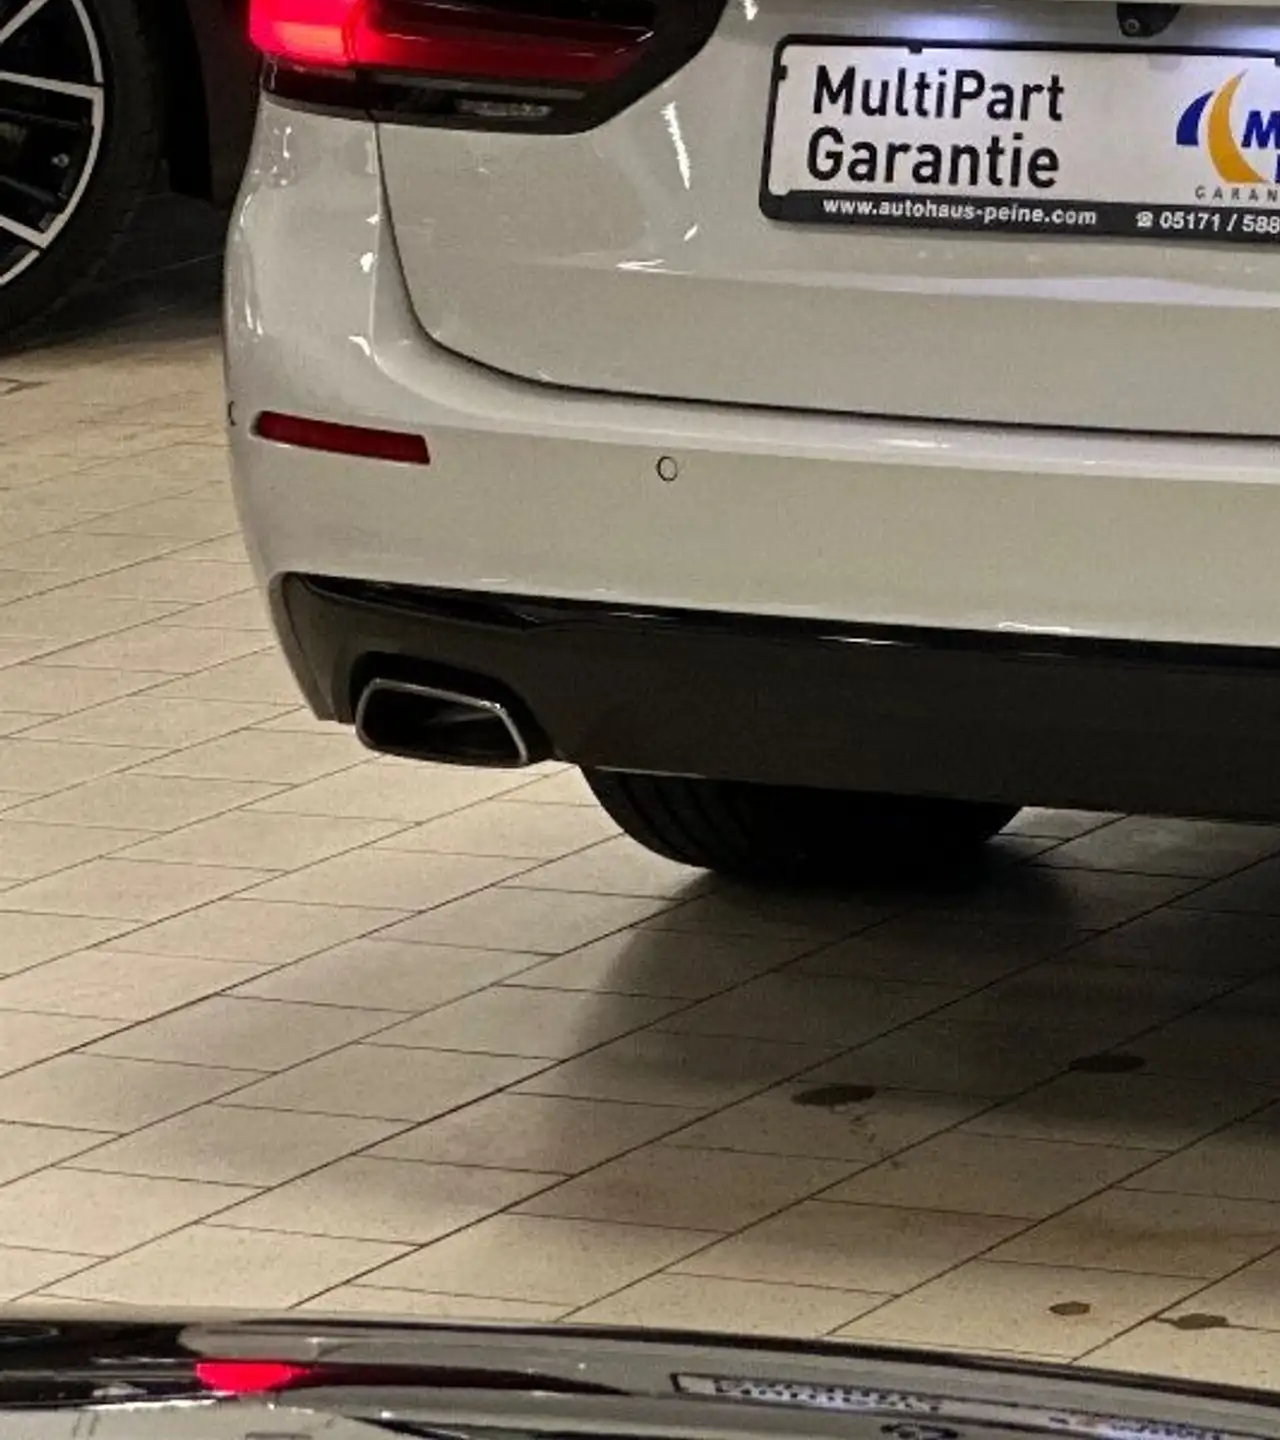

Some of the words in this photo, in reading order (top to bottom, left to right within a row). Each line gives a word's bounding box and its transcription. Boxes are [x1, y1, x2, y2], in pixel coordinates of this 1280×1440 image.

[813, 65, 1065, 121] MultiPart
[807, 126, 1059, 188] Garantie
[822, 197, 1097, 225] www.autohaus-peine.com
[1159, 211, 1221, 231] 05171
[1242, 216, 1280, 233] 588
